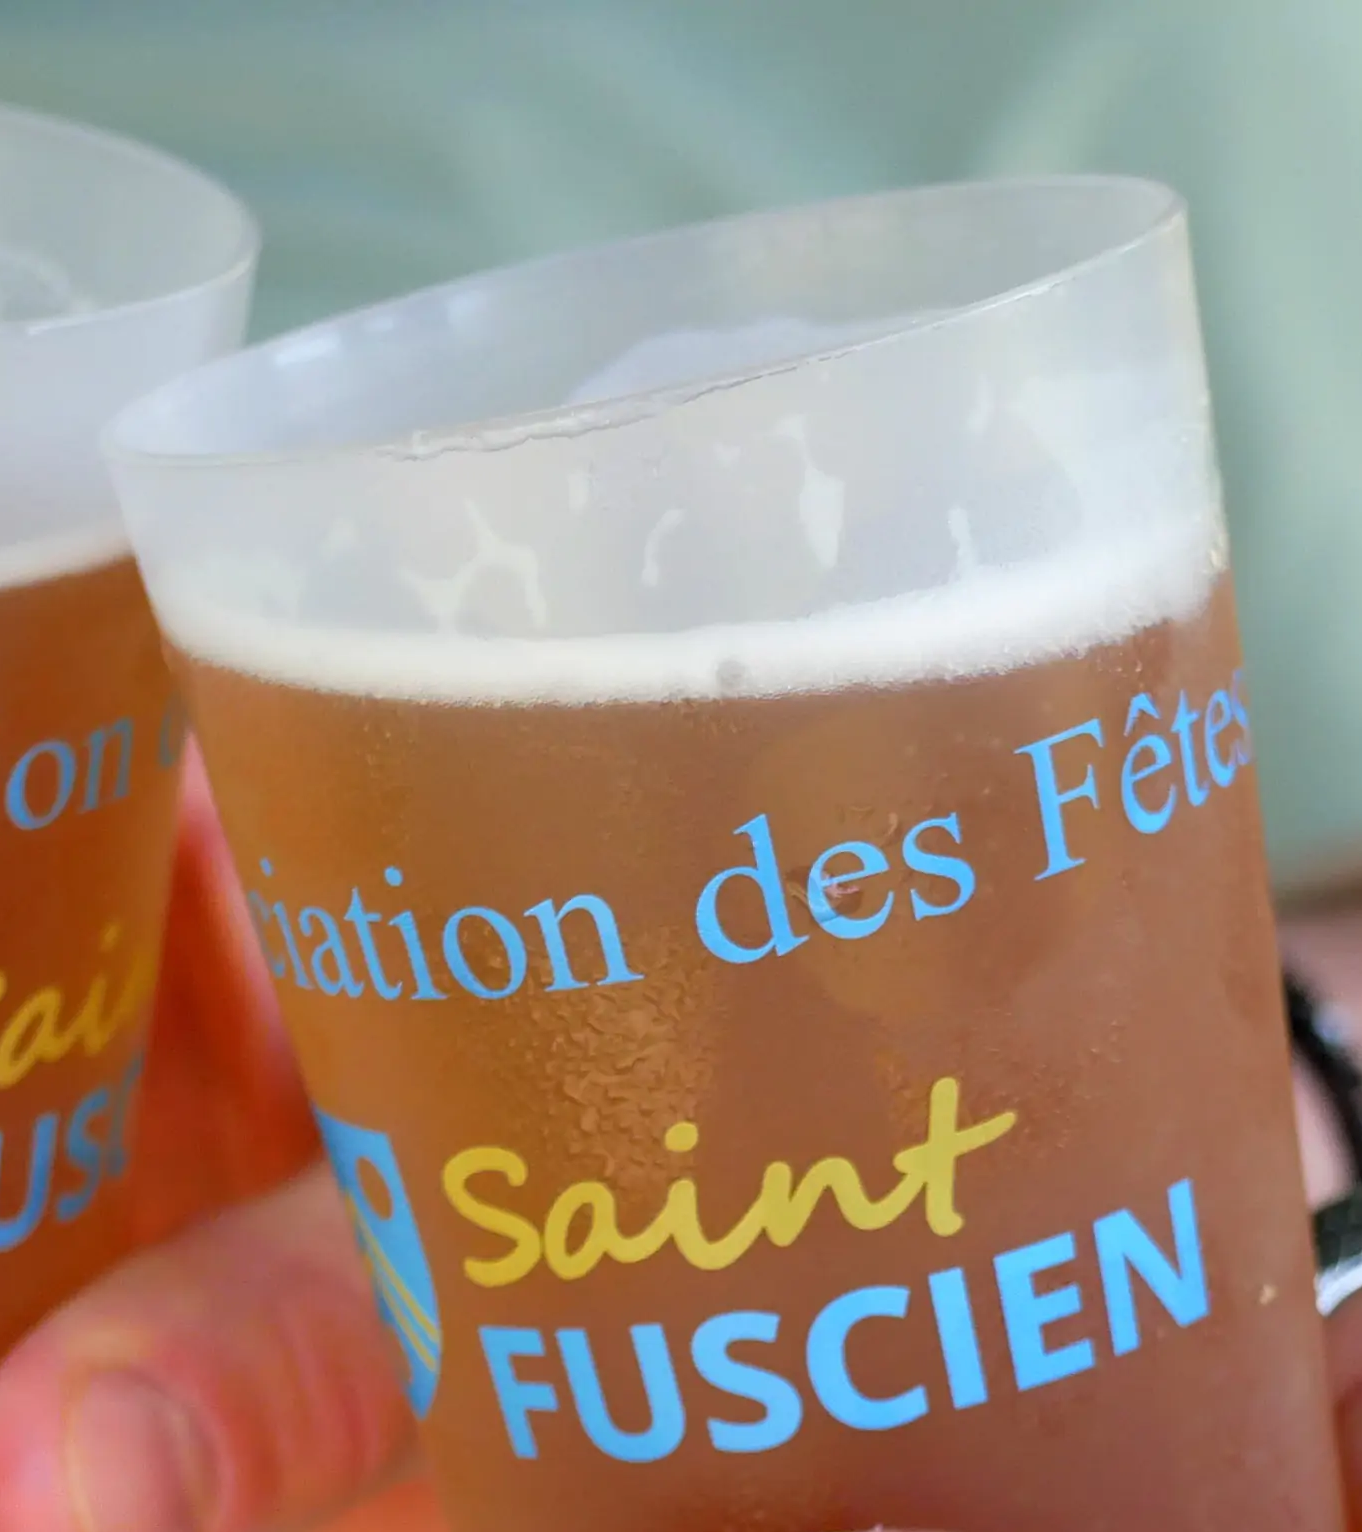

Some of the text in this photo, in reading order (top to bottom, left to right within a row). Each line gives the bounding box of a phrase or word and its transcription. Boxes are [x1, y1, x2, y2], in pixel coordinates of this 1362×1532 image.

[246, 857, 645, 1001] ciation
[694, 813, 978, 966] des
[442, 1076, 1017, 1288] Saint
[477, 1177, 1212, 1464] FUSCIEN
